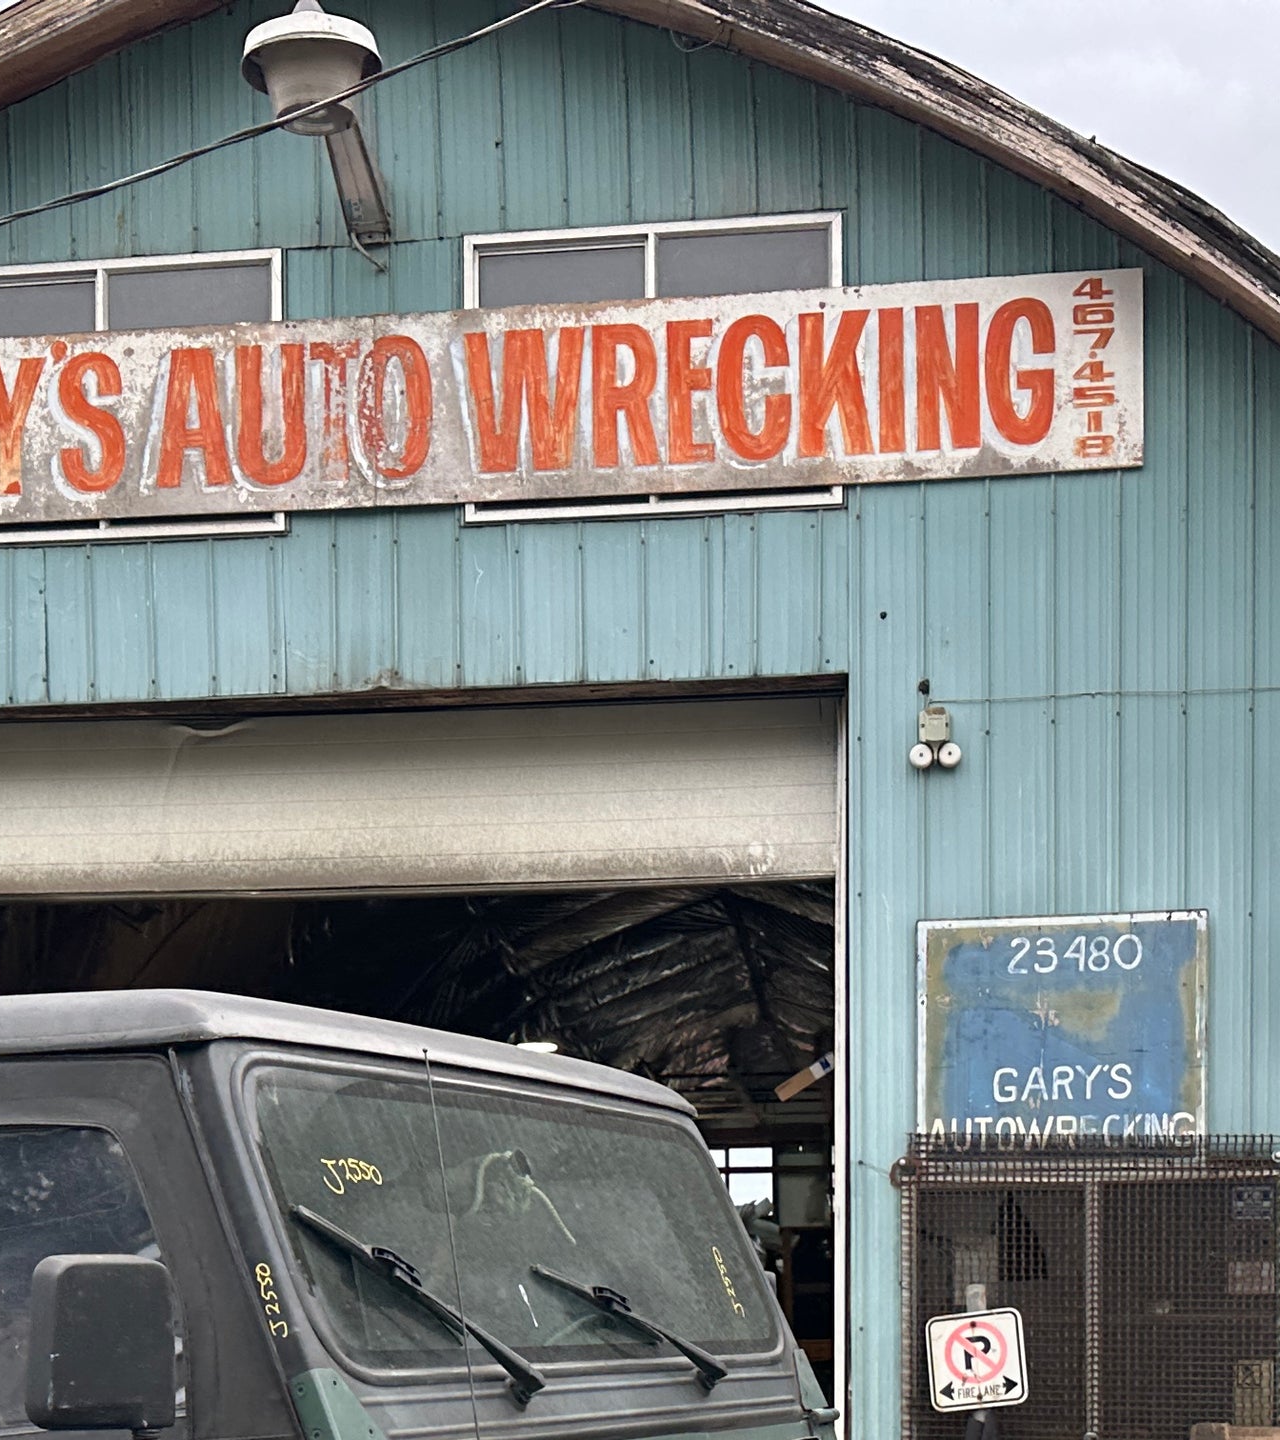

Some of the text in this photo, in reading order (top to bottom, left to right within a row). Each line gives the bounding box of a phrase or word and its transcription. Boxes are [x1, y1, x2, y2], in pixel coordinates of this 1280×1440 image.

[157, 334, 432, 488] AUTO
[464, 297, 1057, 473] WRECKING
[1007, 933, 1143, 975] 23480
[992, 1062, 1133, 1103] GARY'S
[320, 1157, 383, 1195] J2550
[255, 1262, 289, 1338] J2550
[957, 1386, 977, 1399] FIRE
